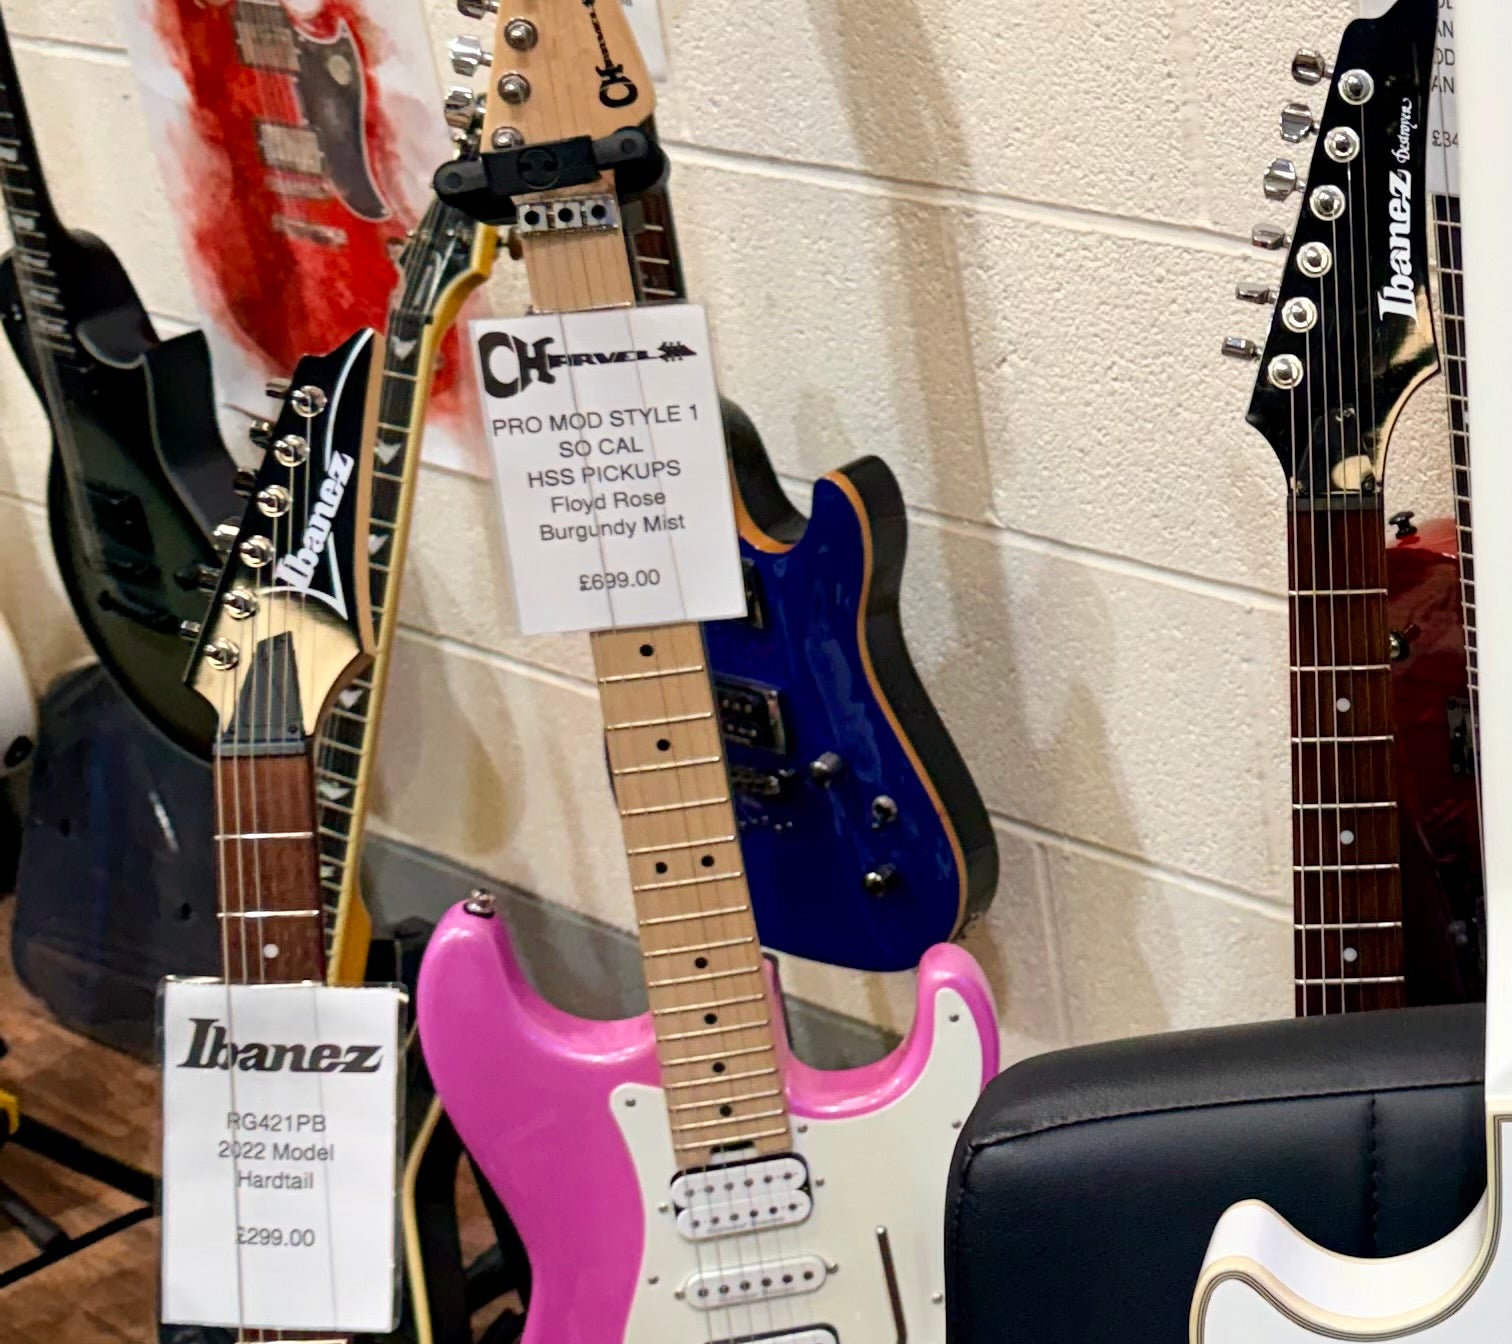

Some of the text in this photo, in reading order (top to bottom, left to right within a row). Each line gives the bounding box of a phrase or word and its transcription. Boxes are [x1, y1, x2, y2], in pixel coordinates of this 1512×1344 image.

[1377, 168, 1419, 329] Ibanez
[492, 404, 700, 437] PRO MOD STYLE 1
[559, 436, 644, 458] SO CAL
[528, 460, 682, 488] HSS PICKUPS
[551, 491, 667, 515] Floyd Rose
[272, 449, 355, 590] Ibanez
[540, 515, 687, 543] Burgundy Mist
[579, 569, 661, 592] £699.00
[176, 1017, 384, 1074] Ibanez
[226, 1112, 327, 1133] RG421PB
[218, 1141, 335, 1162] 2022 Model
[237, 1170, 314, 1190] Hardtail
[235, 1225, 316, 1248] £299.00
